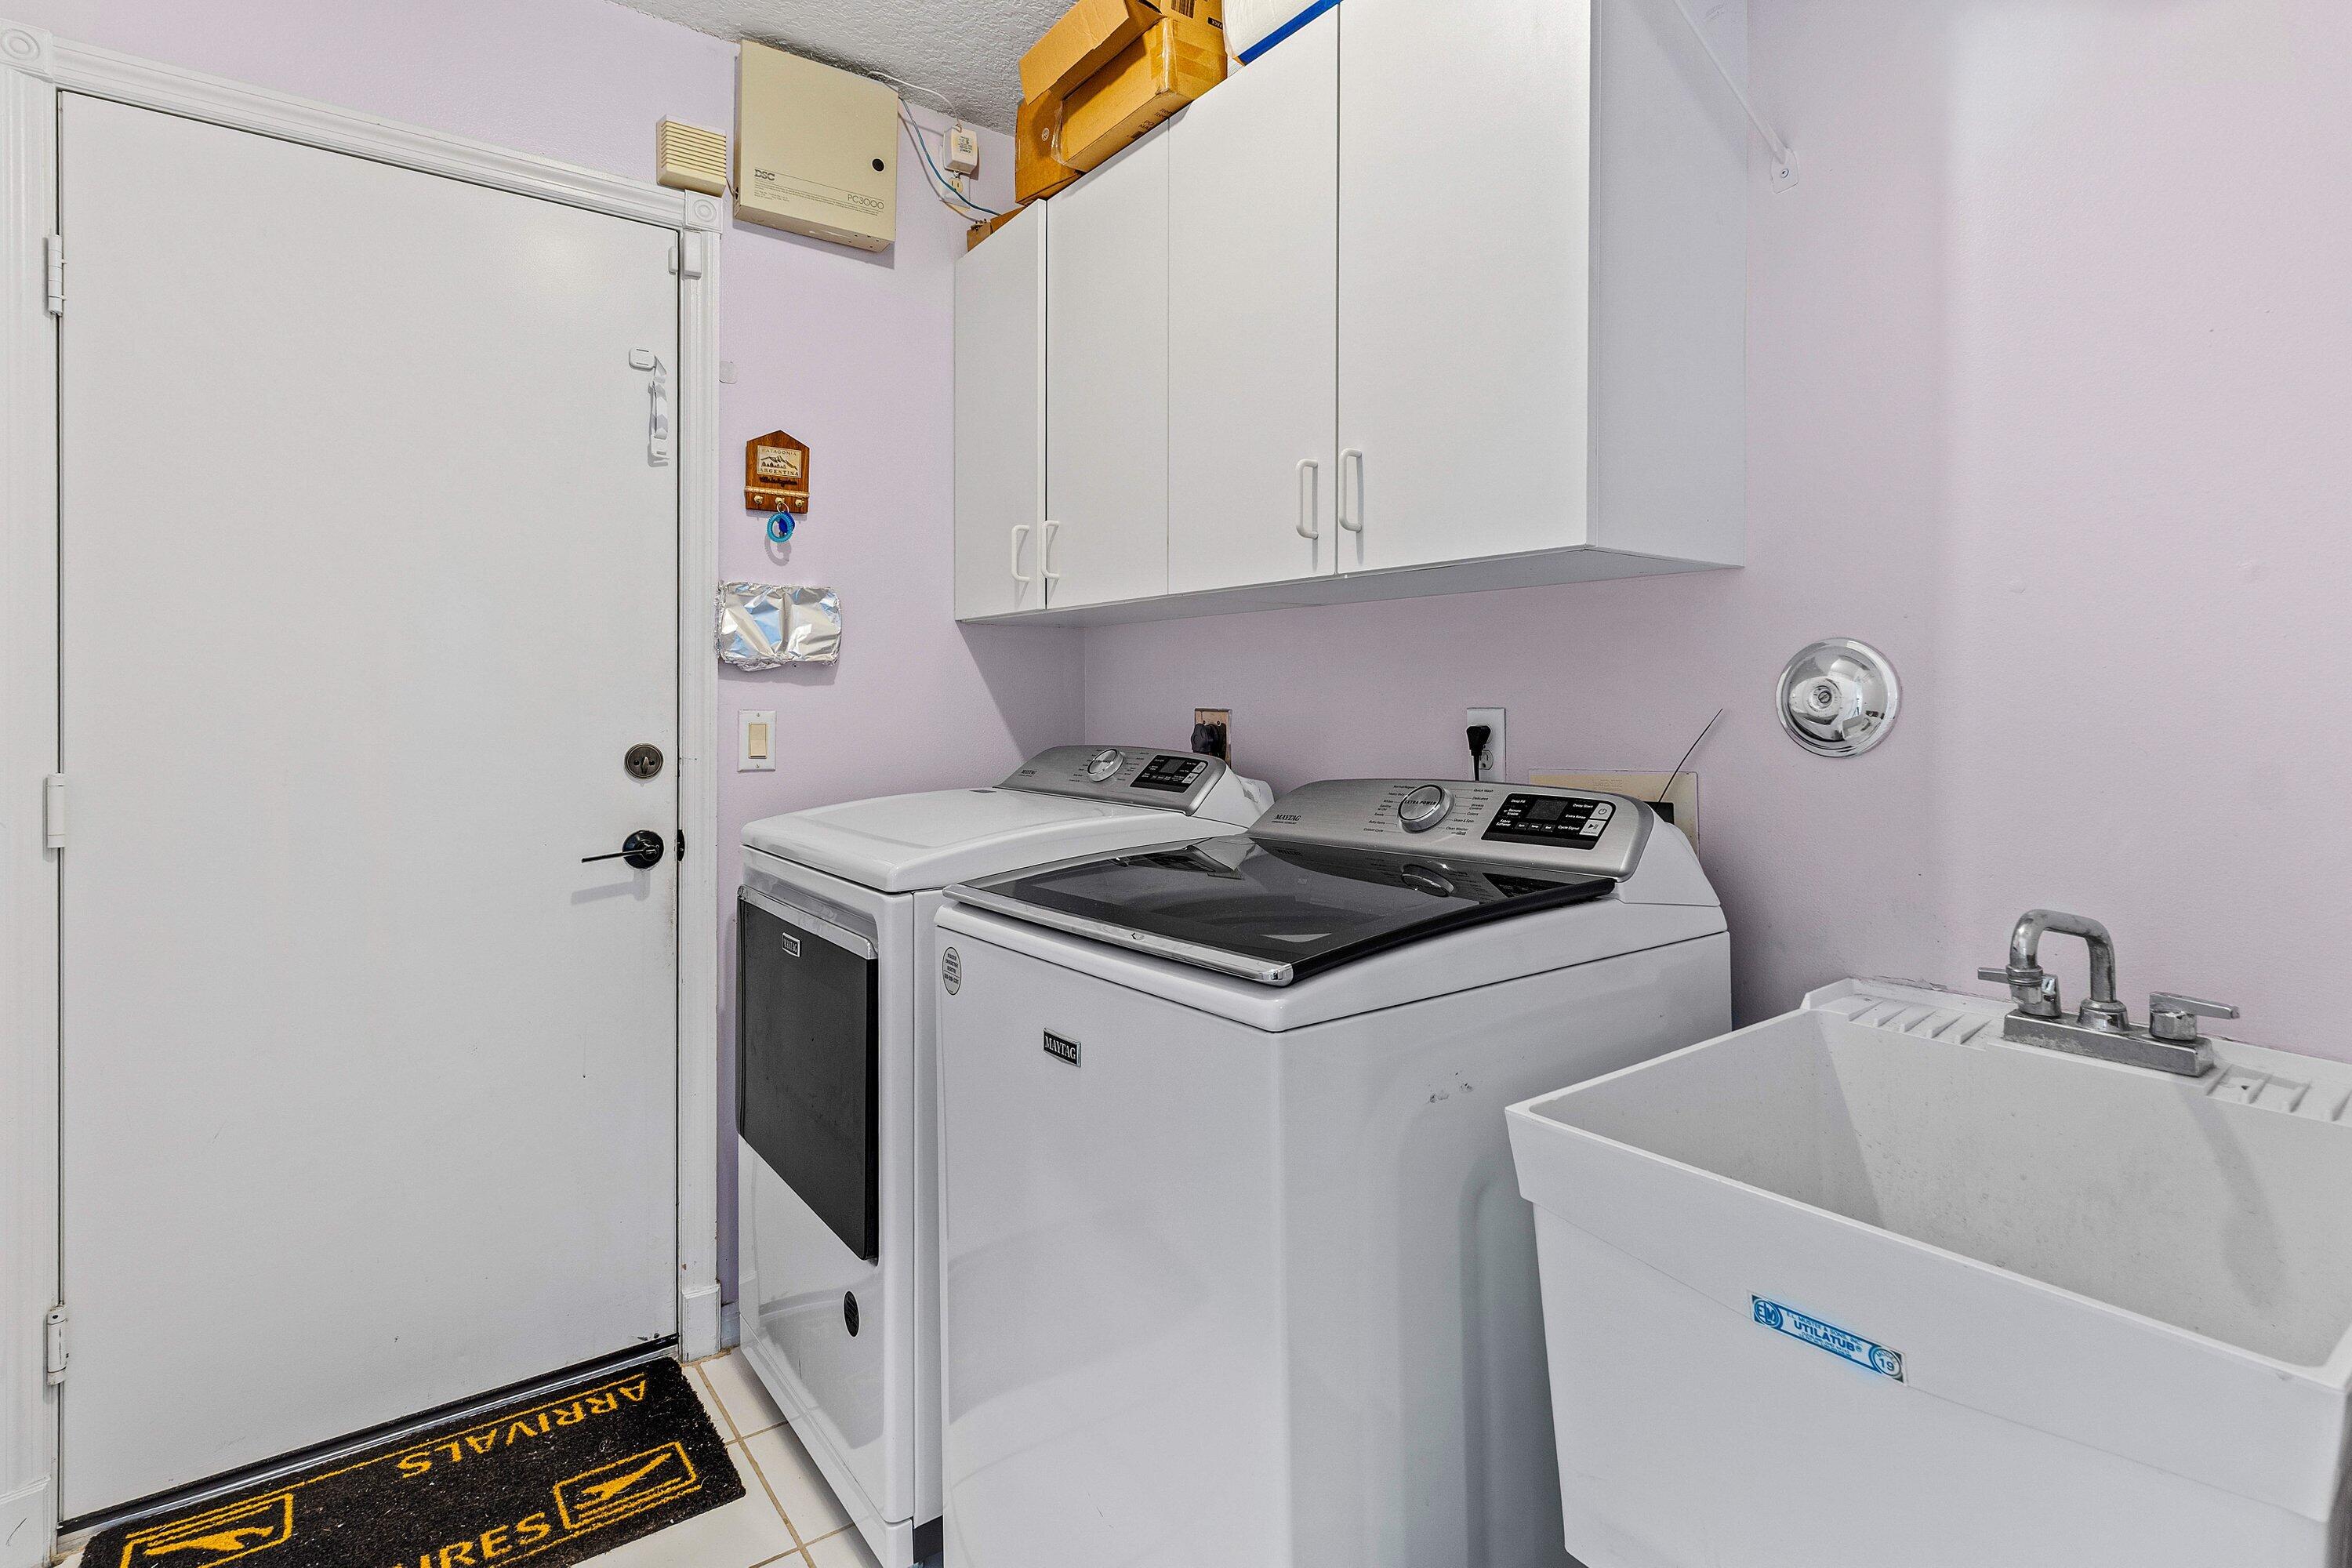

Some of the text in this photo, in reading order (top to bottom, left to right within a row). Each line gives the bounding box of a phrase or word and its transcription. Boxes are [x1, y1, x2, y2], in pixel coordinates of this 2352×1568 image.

[754, 169, 775, 181] DSC
[848, 193, 885, 210] PC3000
[760, 468, 799, 477] ARGENTINA
[1044, 1035, 1076, 1060] MAYTAG
[1879, 1358, 1894, 1371] 19
[397, 1379, 647, 1479] ARRIVALS
